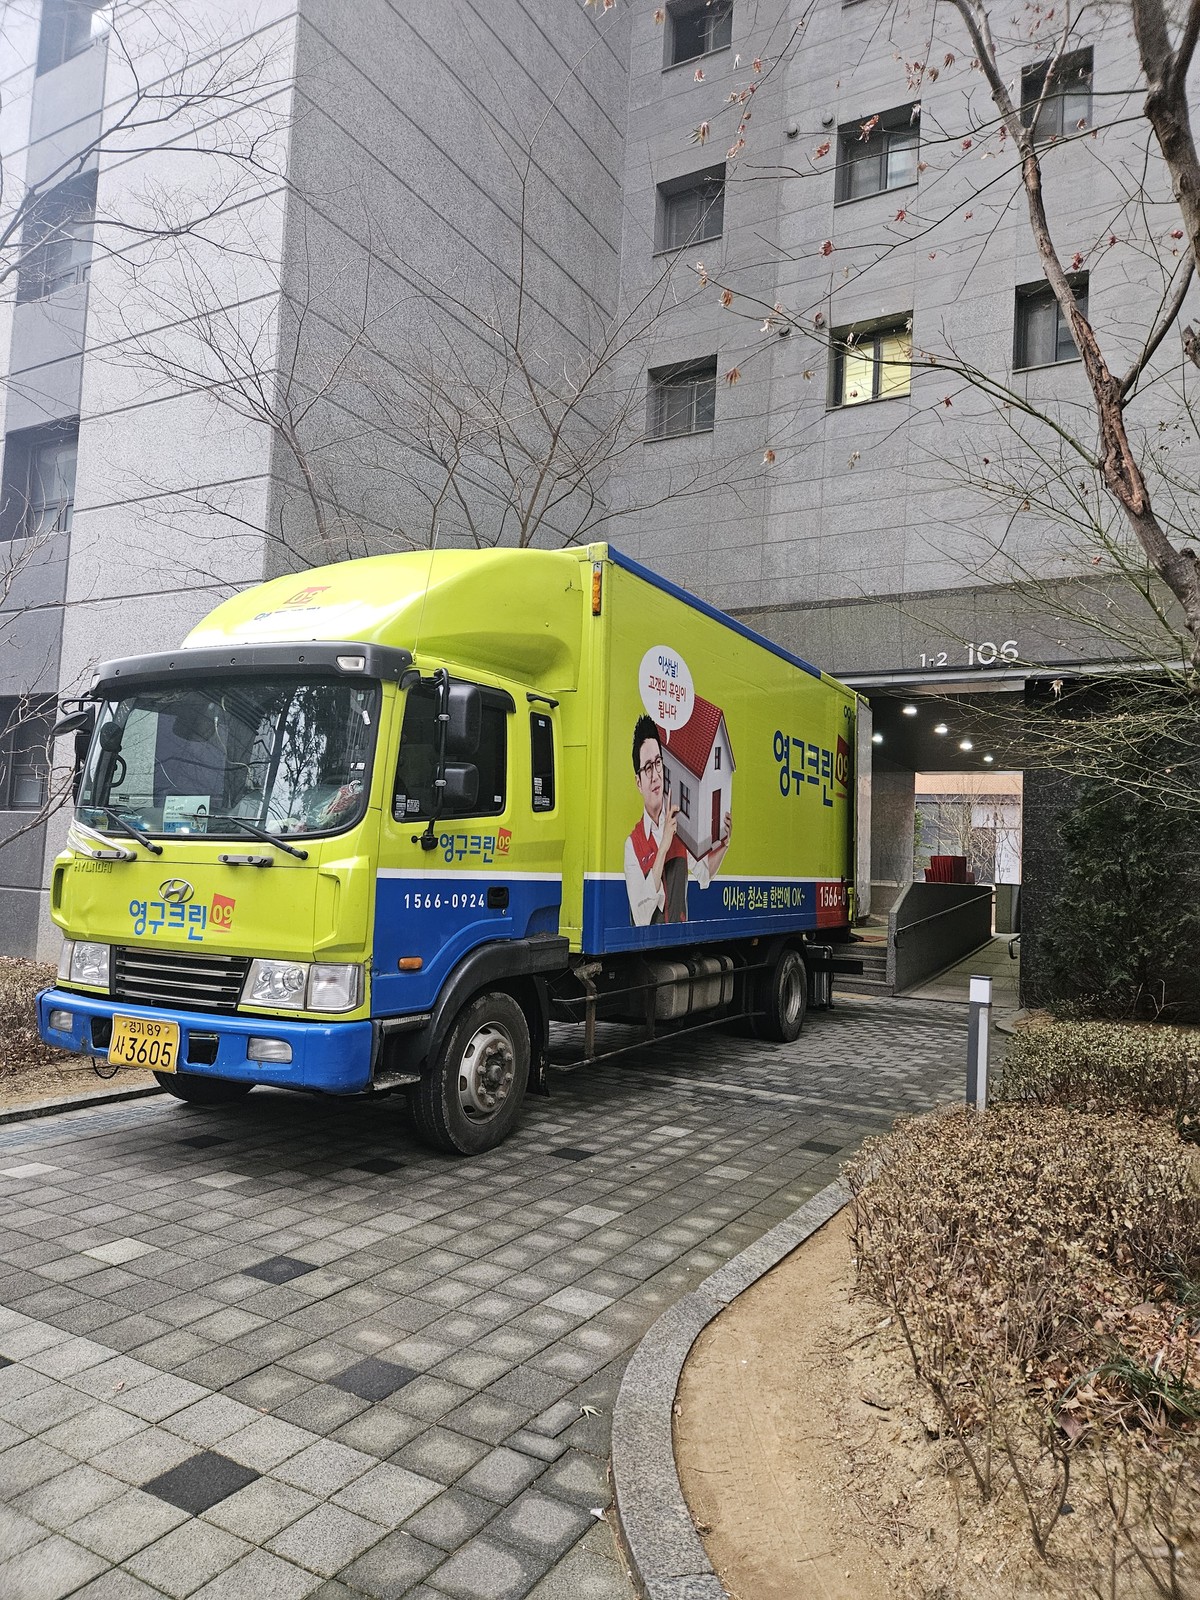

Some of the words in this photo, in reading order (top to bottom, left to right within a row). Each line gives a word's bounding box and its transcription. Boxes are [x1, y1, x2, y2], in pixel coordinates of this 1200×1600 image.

[919, 651, 948, 667] 1-2
[967, 640, 1019, 666] 106
[648, 675, 668, 696] 고객의
[669, 681, 687, 702] 휴일이
[658, 700, 677, 720] 됩니다
[773, 730, 833, 808] 영구크린
[439, 833, 496, 863] 영구크린
[498, 835, 511, 850] 09
[74, 861, 112, 873] HYUNDAI
[404, 893, 485, 909] 1566-0924
[722, 886, 746, 911] 이사와
[747, 886, 768, 910] 청소를
[770, 886, 791, 909] 한번에
[129, 899, 207, 941] 영구크린
[212, 904, 235, 924] 09
